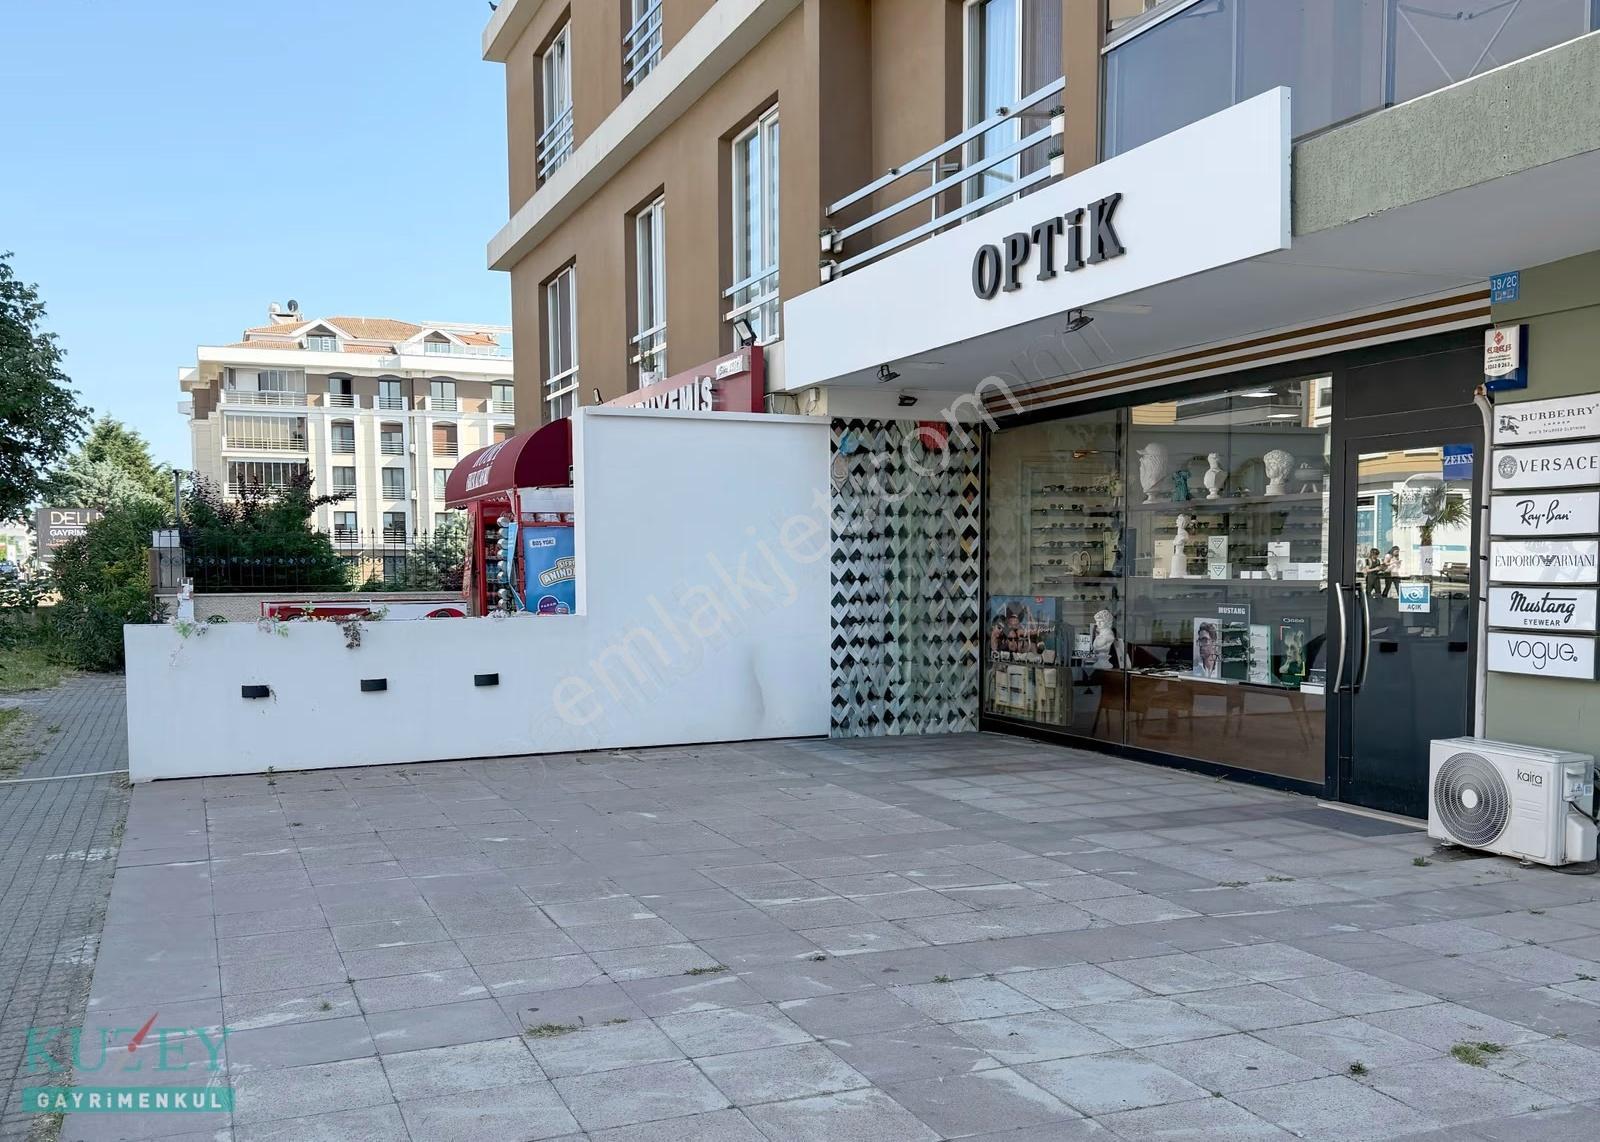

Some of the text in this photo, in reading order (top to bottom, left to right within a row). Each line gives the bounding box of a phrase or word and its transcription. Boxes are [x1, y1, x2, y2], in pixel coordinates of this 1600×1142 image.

[1520, 406, 1595, 422] BURBERRY
[1444, 453, 1473, 466] ZEISS
[1519, 455, 1599, 473] VERSACE
[1495, 554, 1595, 567] EMPORIO ARMANI
[1218, 606, 1246, 615] MUSTANG
[1509, 590, 1577, 624] Mustang
[1523, 618, 1560, 626] EYEWEAR
